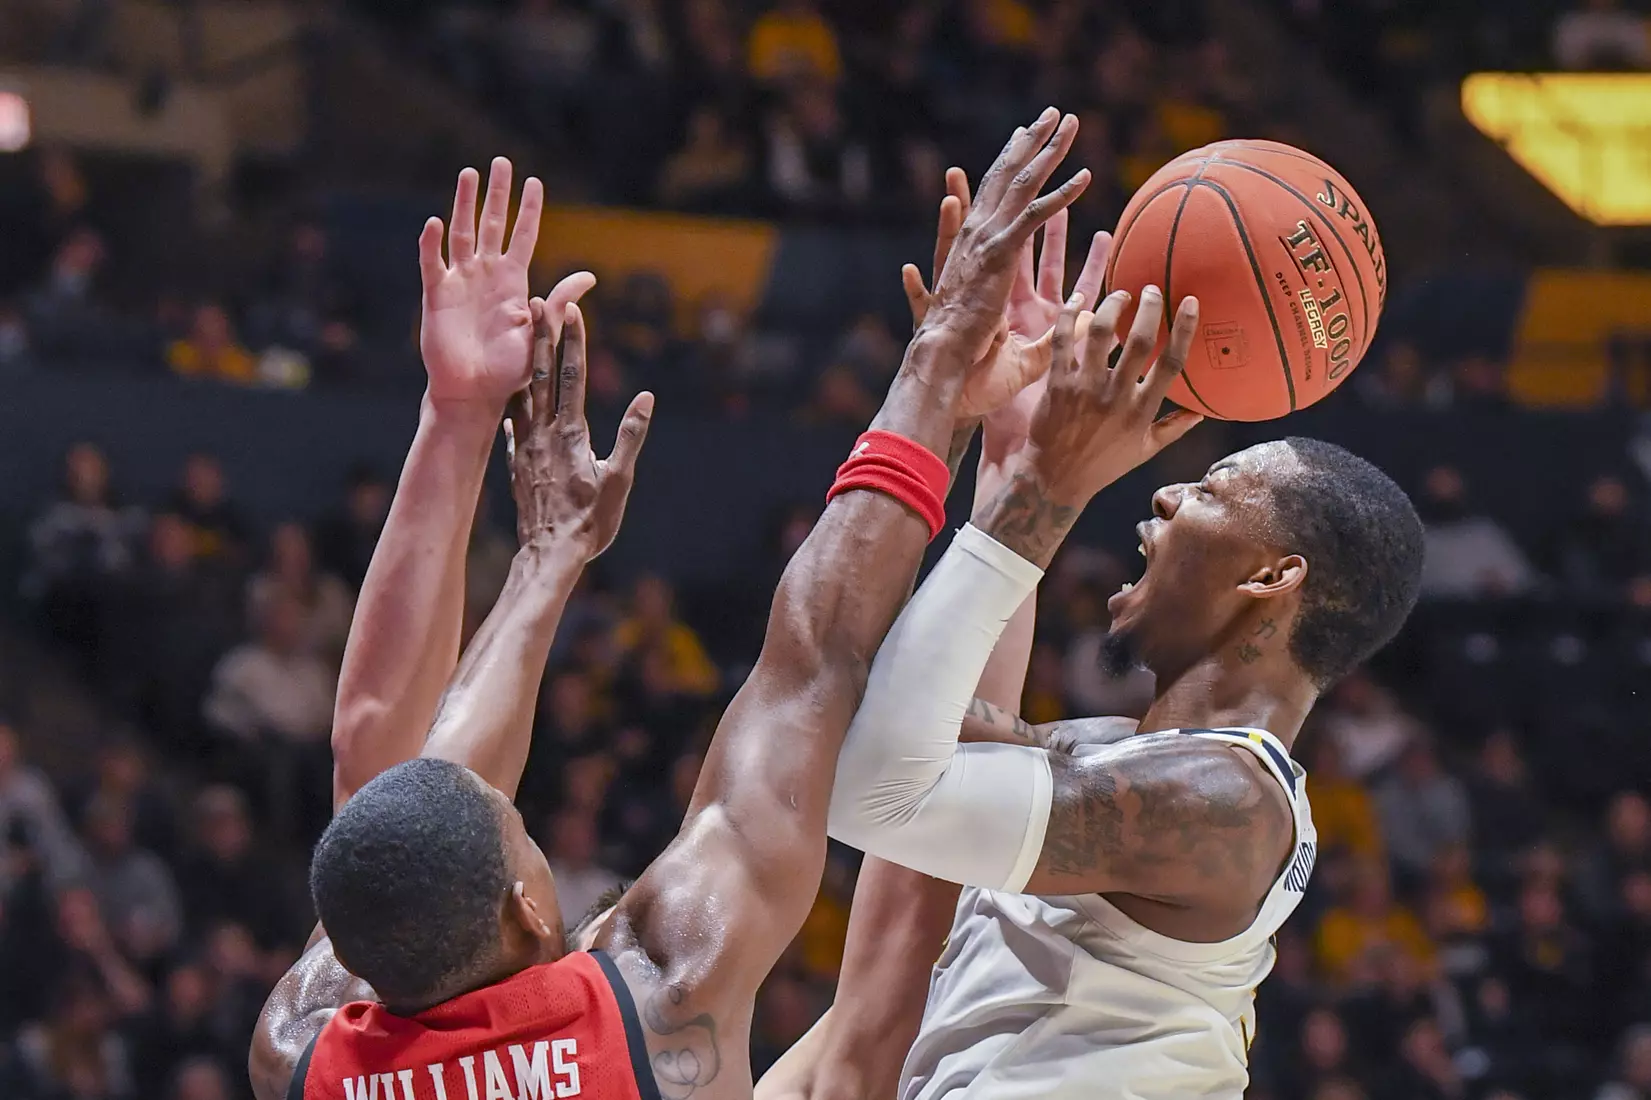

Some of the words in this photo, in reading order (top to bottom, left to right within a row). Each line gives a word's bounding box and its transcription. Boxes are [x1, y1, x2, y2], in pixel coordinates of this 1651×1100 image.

[1316, 179, 1385, 308] SPALD
[1275, 271, 1292, 297] DEEP
[1289, 301, 1309, 347] CHANNEL
[1286, 219, 1351, 381] TF-1000
[1298, 289, 1328, 348] LEGACY
